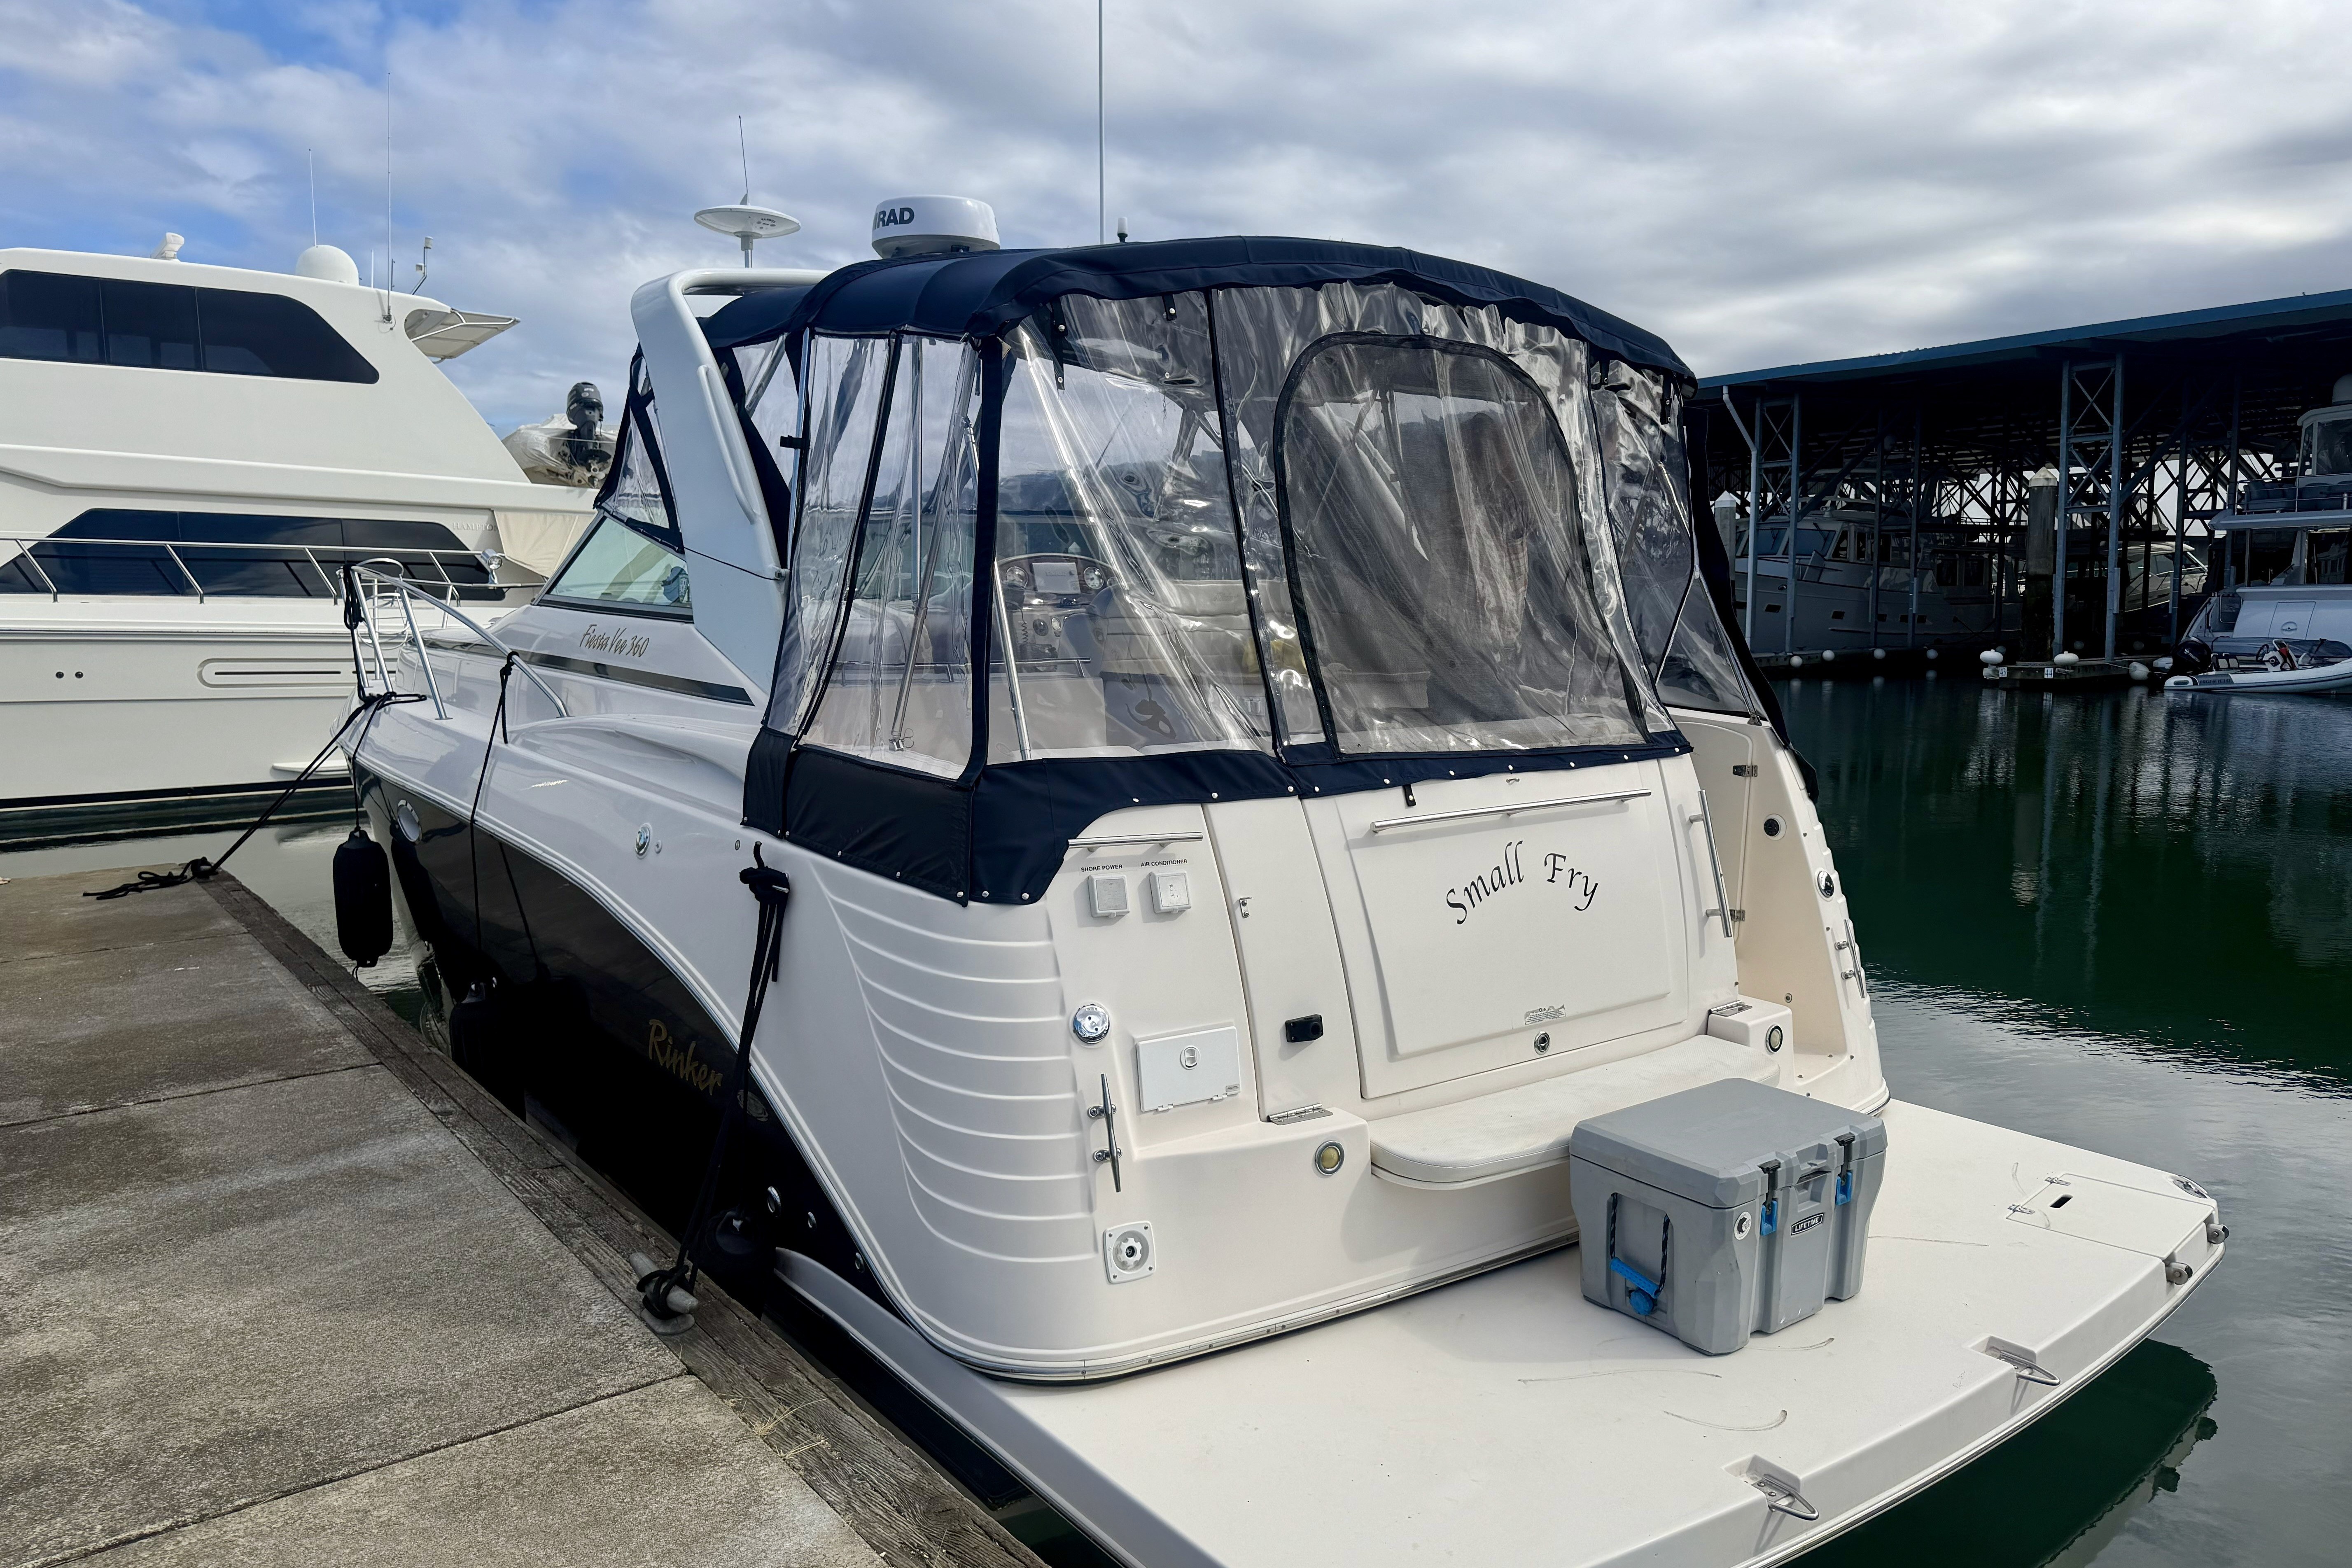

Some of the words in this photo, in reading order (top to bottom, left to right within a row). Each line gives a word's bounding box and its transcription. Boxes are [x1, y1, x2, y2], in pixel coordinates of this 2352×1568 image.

[453, 522, 497, 532] HAMPTO
[579, 624, 610, 651] Fiesta
[608, 627, 627, 655] Vee
[625, 635, 649, 658] 360
[1446, 840, 1524, 925] Small
[1544, 853, 1598, 911] Fry
[648, 1019, 723, 1096] Rinker
[1795, 1216, 1820, 1232] LIFETIME
